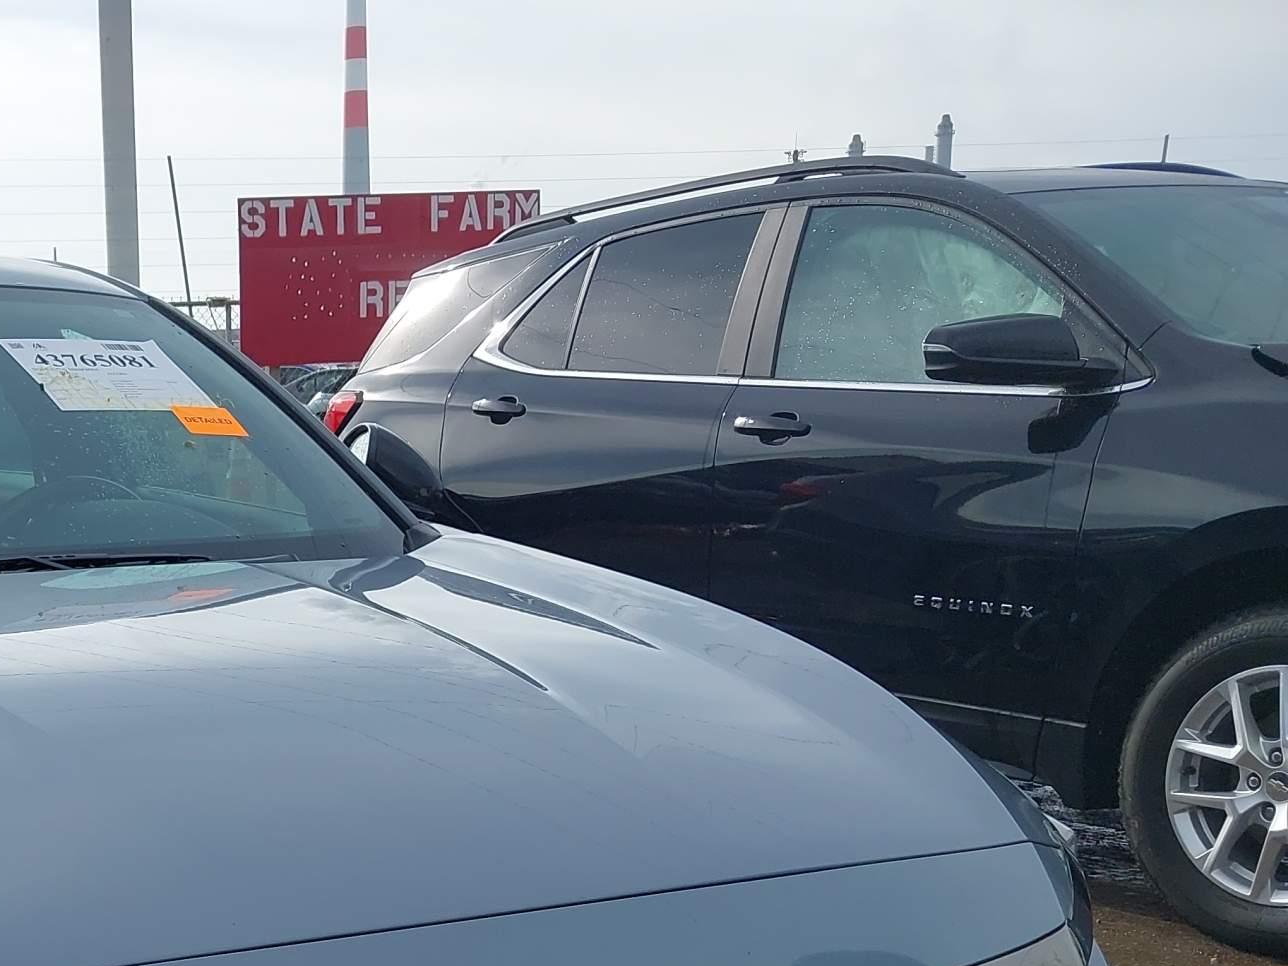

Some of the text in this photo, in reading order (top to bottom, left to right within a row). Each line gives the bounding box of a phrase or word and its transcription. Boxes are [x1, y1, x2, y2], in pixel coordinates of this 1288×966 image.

[240, 192, 538, 238] STATE FARM
[34, 353, 157, 368] 43765081
[913, 594, 1033, 618] EQUINOX
